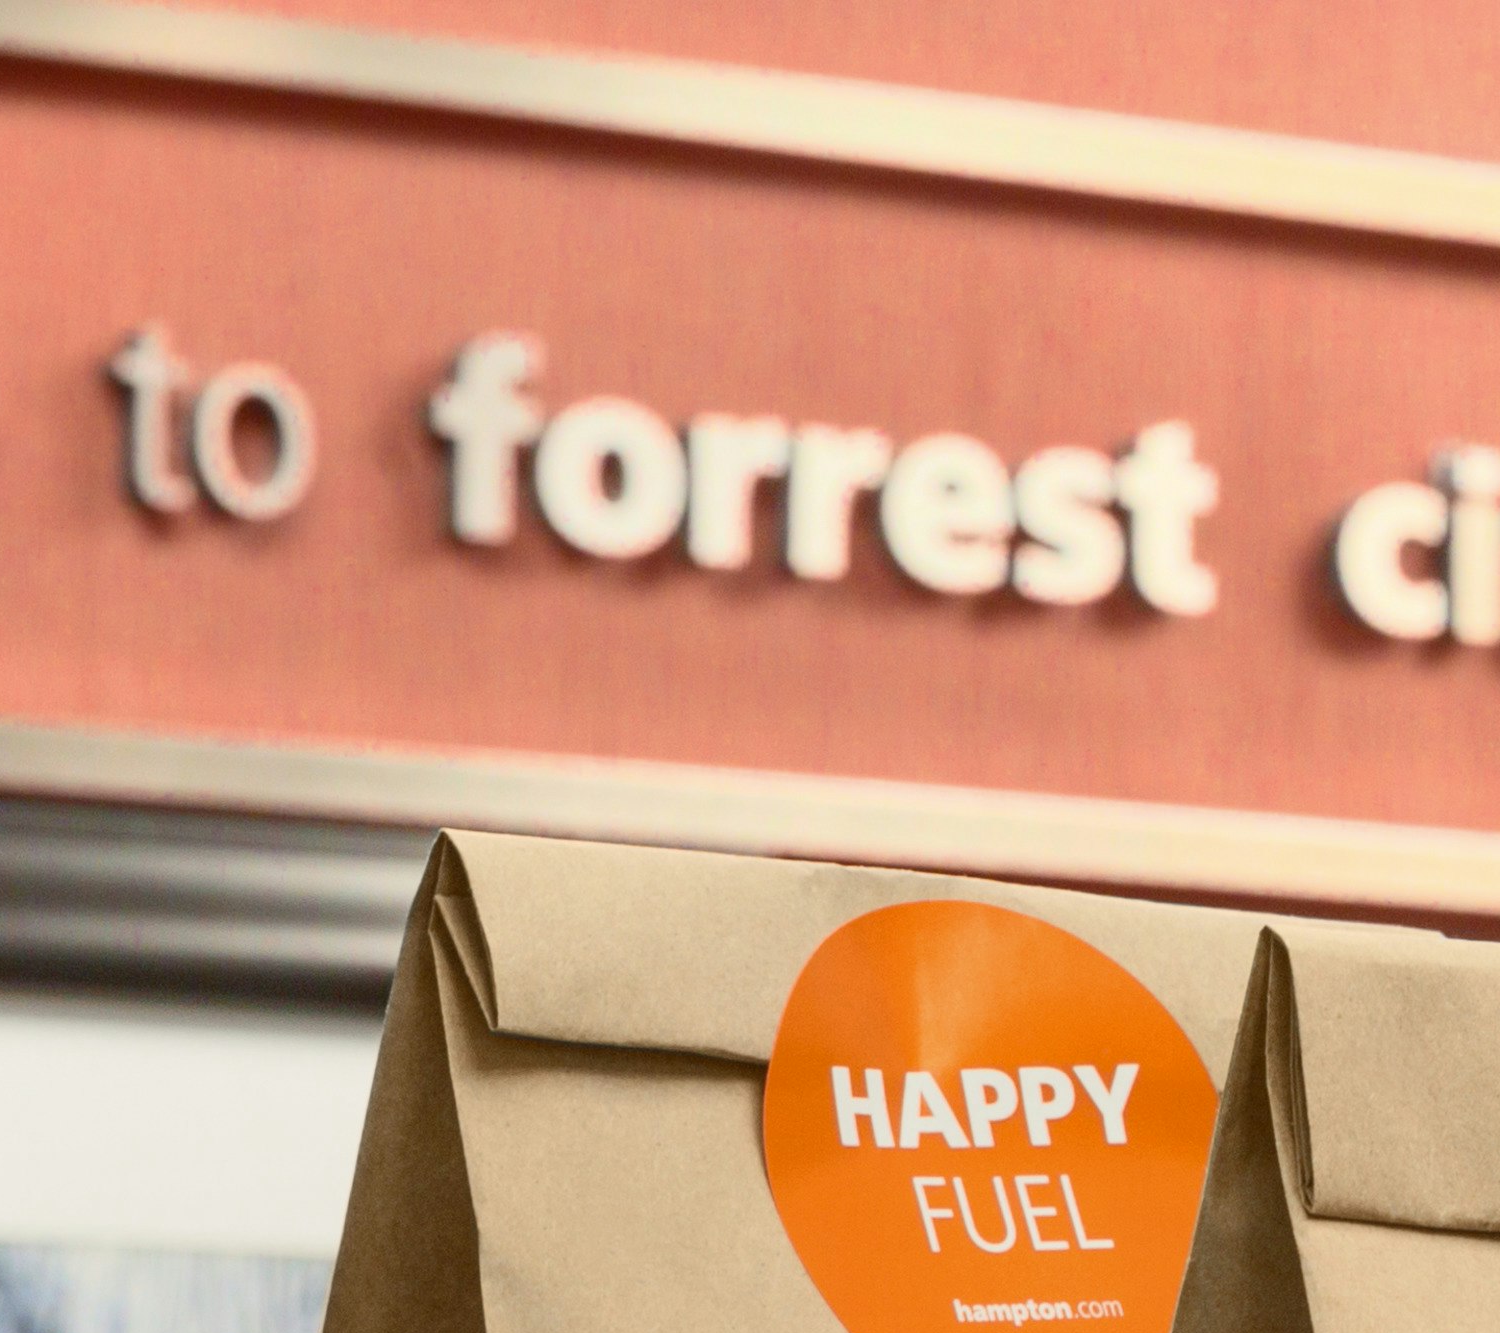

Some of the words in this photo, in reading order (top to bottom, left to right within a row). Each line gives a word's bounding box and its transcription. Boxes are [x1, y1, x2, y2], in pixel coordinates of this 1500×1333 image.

[108, 322, 318, 520] to
[430, 330, 1220, 618] forrest
[830, 1063, 1140, 1150] HAPPY
[912, 1174, 1115, 1254] FUEL
[953, 1298, 1124, 1327] hampton.com
